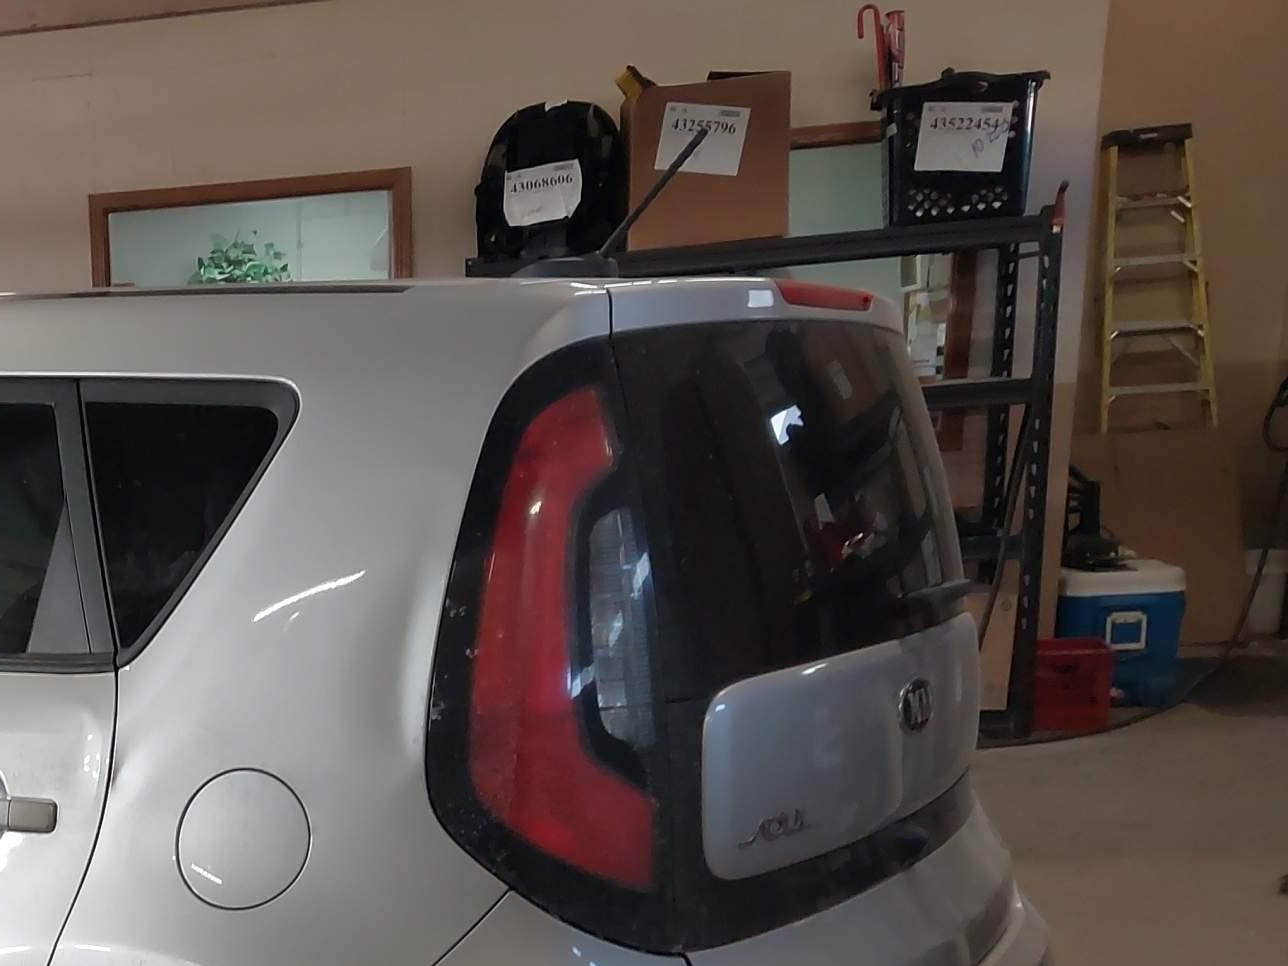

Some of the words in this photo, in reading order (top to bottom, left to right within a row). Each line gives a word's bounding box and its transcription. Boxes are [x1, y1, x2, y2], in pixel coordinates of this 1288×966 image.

[672, 118, 737, 135] 43255796
[930, 117, 999, 130] 43522454
[511, 174, 574, 193] 43068606
